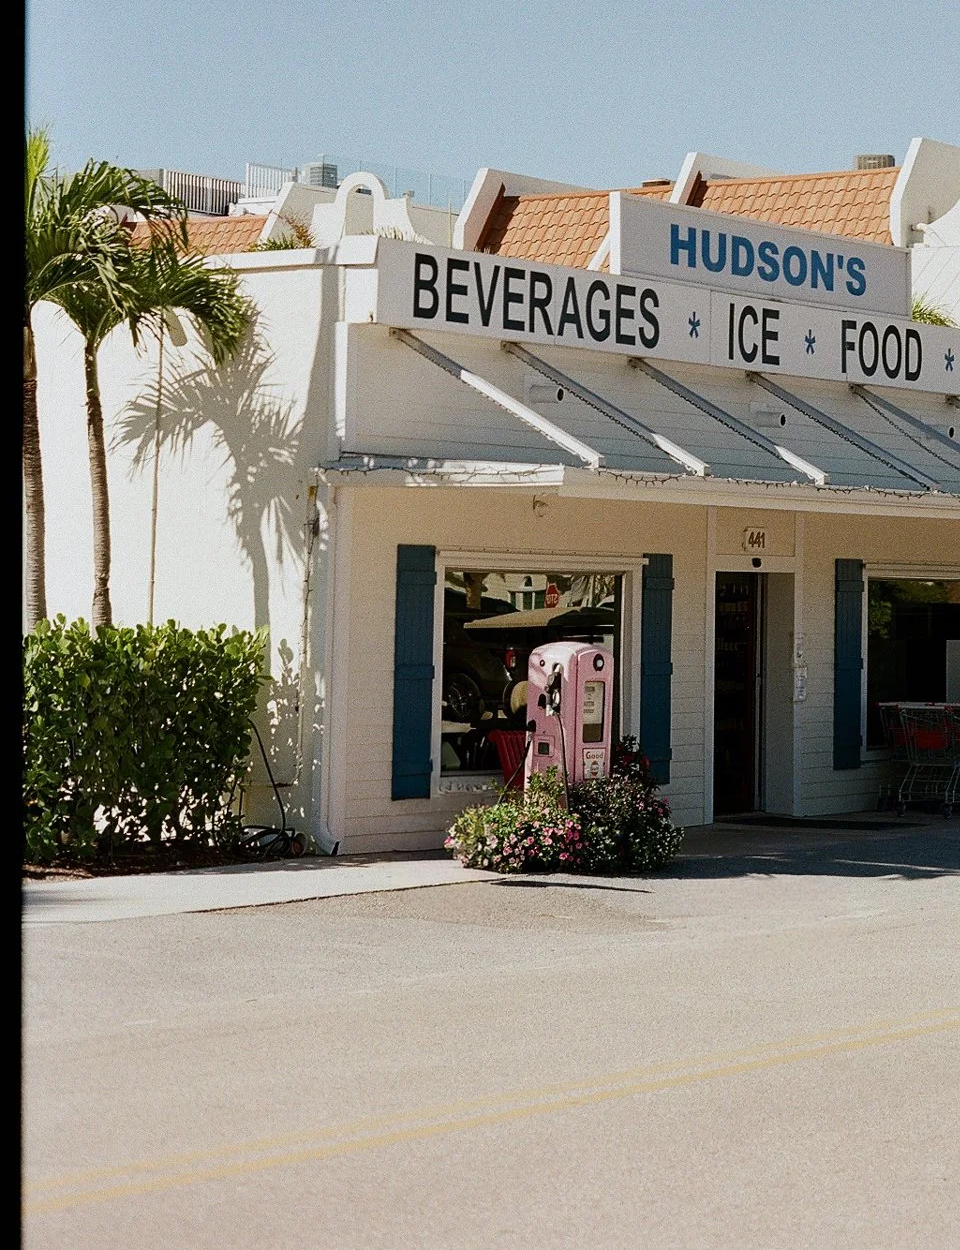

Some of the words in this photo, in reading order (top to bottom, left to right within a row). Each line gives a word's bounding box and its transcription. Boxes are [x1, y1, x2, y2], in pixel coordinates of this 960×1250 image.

[670, 223, 866, 297] HUDSON'S
[413, 253, 660, 349] BEVERAGES
[728, 303, 780, 366] ICE
[841, 319, 923, 382] FOOD
[748, 531, 765, 548] 441
[586, 751, 604, 759] Good
